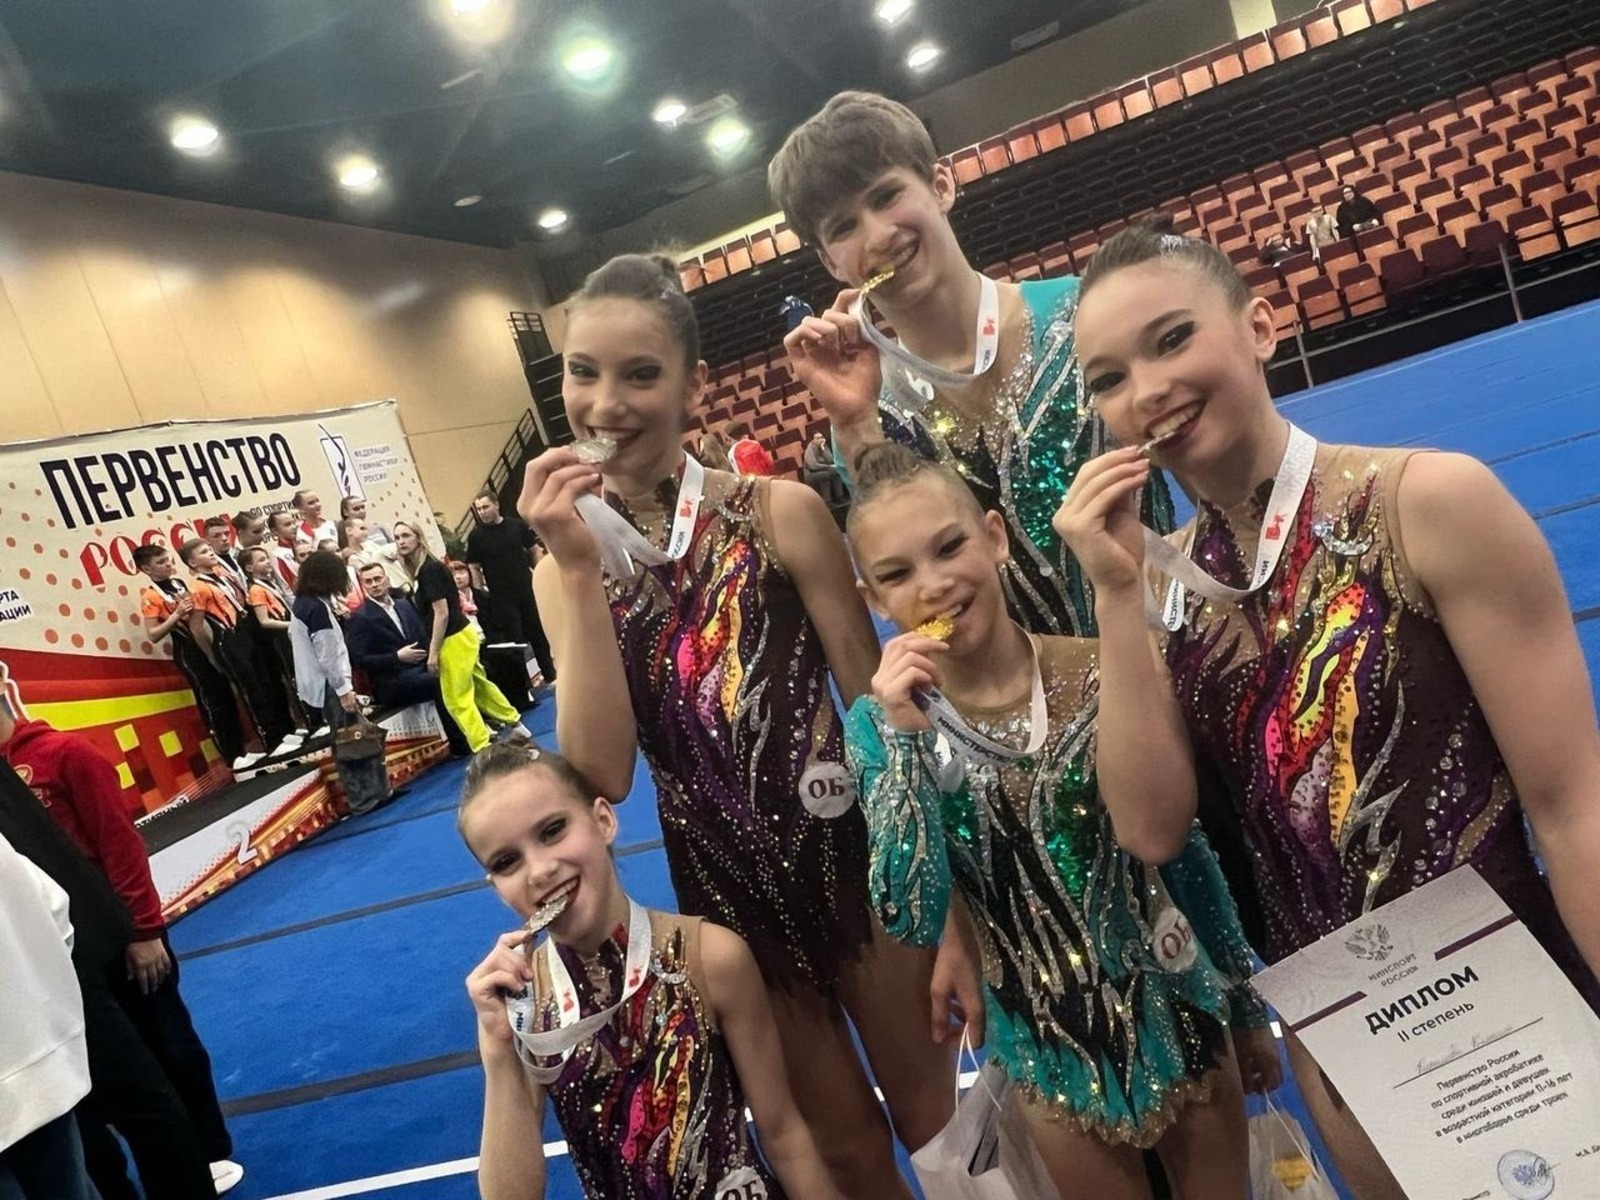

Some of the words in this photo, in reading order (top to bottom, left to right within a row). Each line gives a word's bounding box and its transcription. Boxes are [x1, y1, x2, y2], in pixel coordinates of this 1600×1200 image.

[40, 433, 300, 530] ПЕРВЕНСТВО
[808, 777, 845, 799] ОБ
[226, 821, 258, 865] 2
[1365, 966, 1479, 1035] ДИПЛОМ
[1381, 965, 1419, 987] РОССИИ
[1412, 1003, 1475, 1036] степень
[1431, 1100, 1443, 1109] по
[1443, 1075, 1493, 1103] спортивной
[1493, 1054, 1544, 1081] акробатике
[1437, 1064, 1488, 1090] Первенство
[1487, 1050, 1520, 1067] России
[1441, 1104, 1466, 1120] среди
[1511, 1067, 1550, 1089] девушек
[1442, 1106, 1491, 1134] возрастной
[1491, 1089, 1535, 1112] категории
[1556, 1072, 1573, 1085] лет
[1463, 1115, 1514, 1140] многоборье
[1514, 1103, 1541, 1119] среди
[1541, 1091, 1569, 1107] троек
